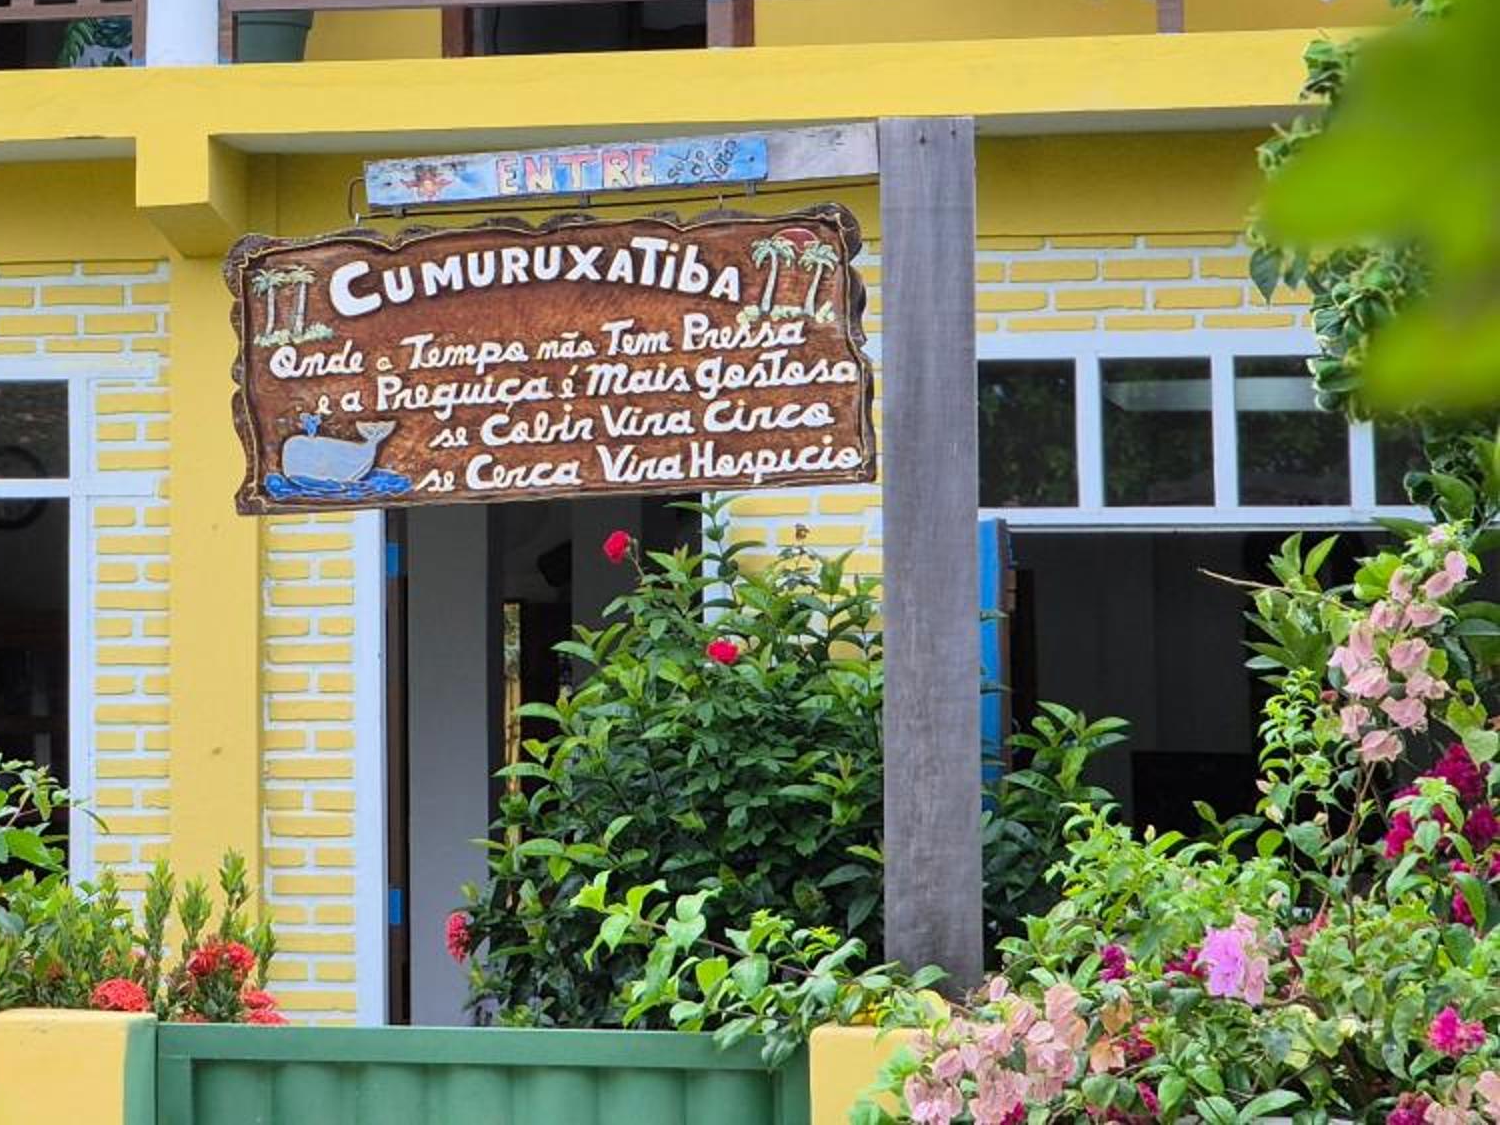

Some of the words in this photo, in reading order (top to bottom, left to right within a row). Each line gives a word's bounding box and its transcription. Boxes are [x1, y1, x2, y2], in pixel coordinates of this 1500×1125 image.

[497, 147, 655, 194] ENTRE
[269, 340, 365, 379] Onde
[401, 333, 529, 375] Tempo
[536, 330, 597, 360] não
[601, 319, 673, 356] Tem
[682, 312, 807, 352] Pressa
[315, 395, 333, 415] e
[341, 390, 364, 413] a
[376, 375, 553, 421] Preguiça
[558, 365, 579, 400] é
[429, 427, 468, 447] se
[480, 404, 593, 446] Cobrir
[600, 404, 695, 437] Vira
[703, 399, 835, 432] Circo
[414, 469, 455, 491] se
[466, 454, 583, 490] Cerca
[596, 444, 684, 483] Vira
